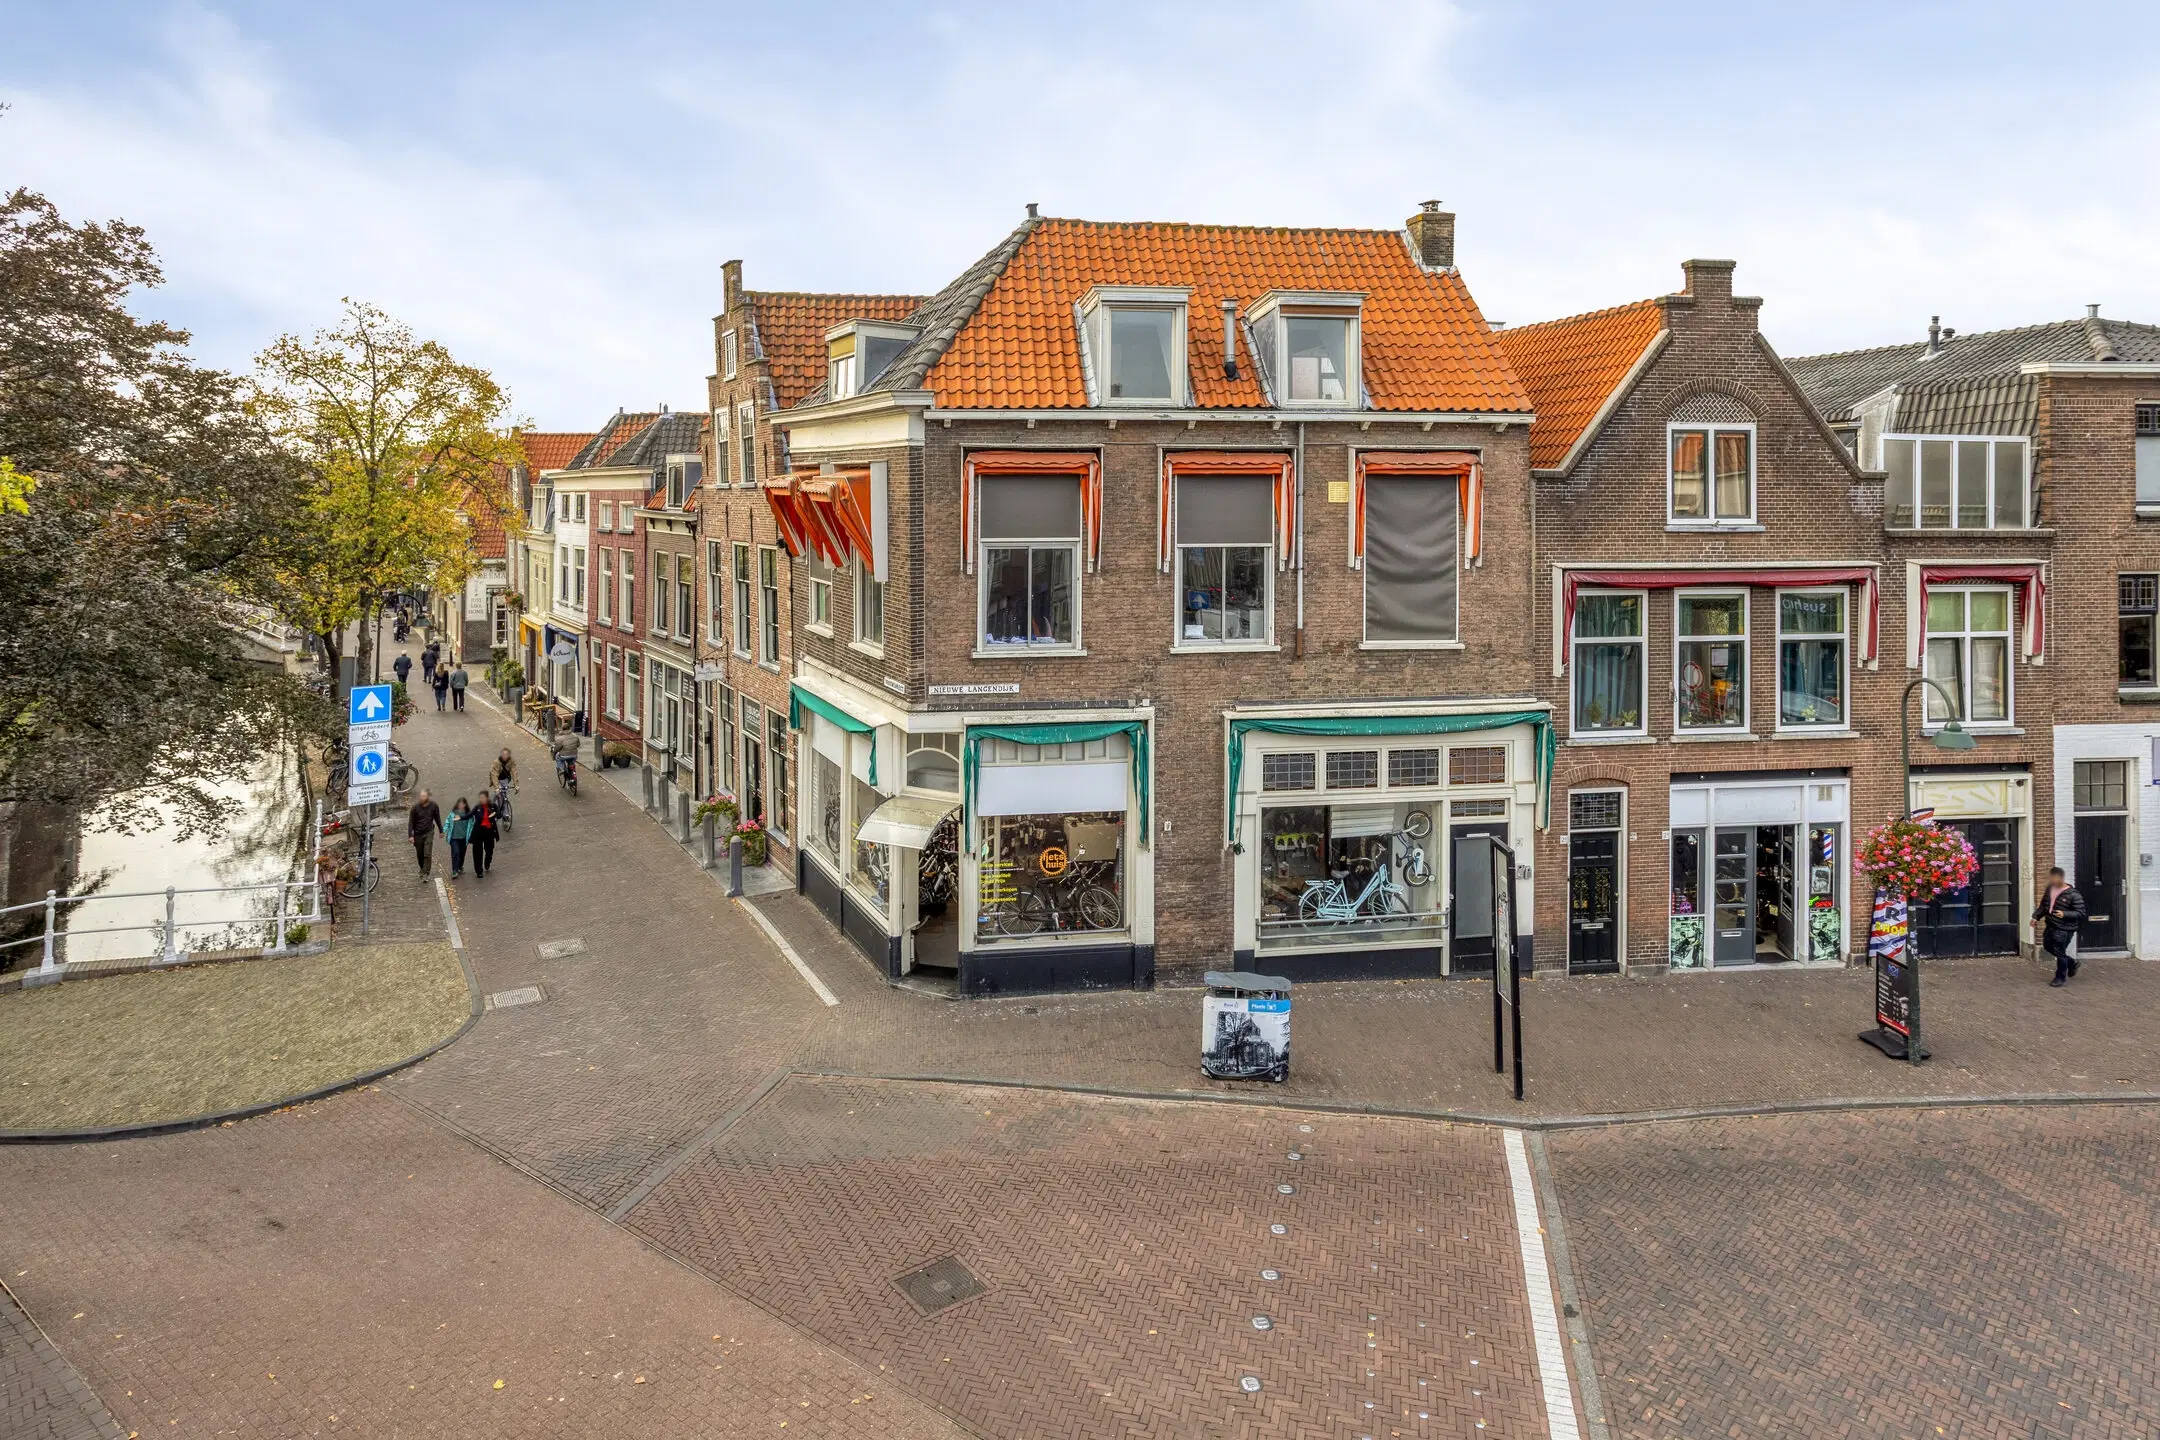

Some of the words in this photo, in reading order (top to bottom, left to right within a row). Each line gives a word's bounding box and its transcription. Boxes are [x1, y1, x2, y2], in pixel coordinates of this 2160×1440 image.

[933, 686, 964, 694] NIEUWE
[968, 685, 1015, 693] LANGENDIJK
[351, 723, 390, 731] uitgezonderd
[1043, 853, 1064, 861] fiets
[1045, 860, 1065, 869] huis
